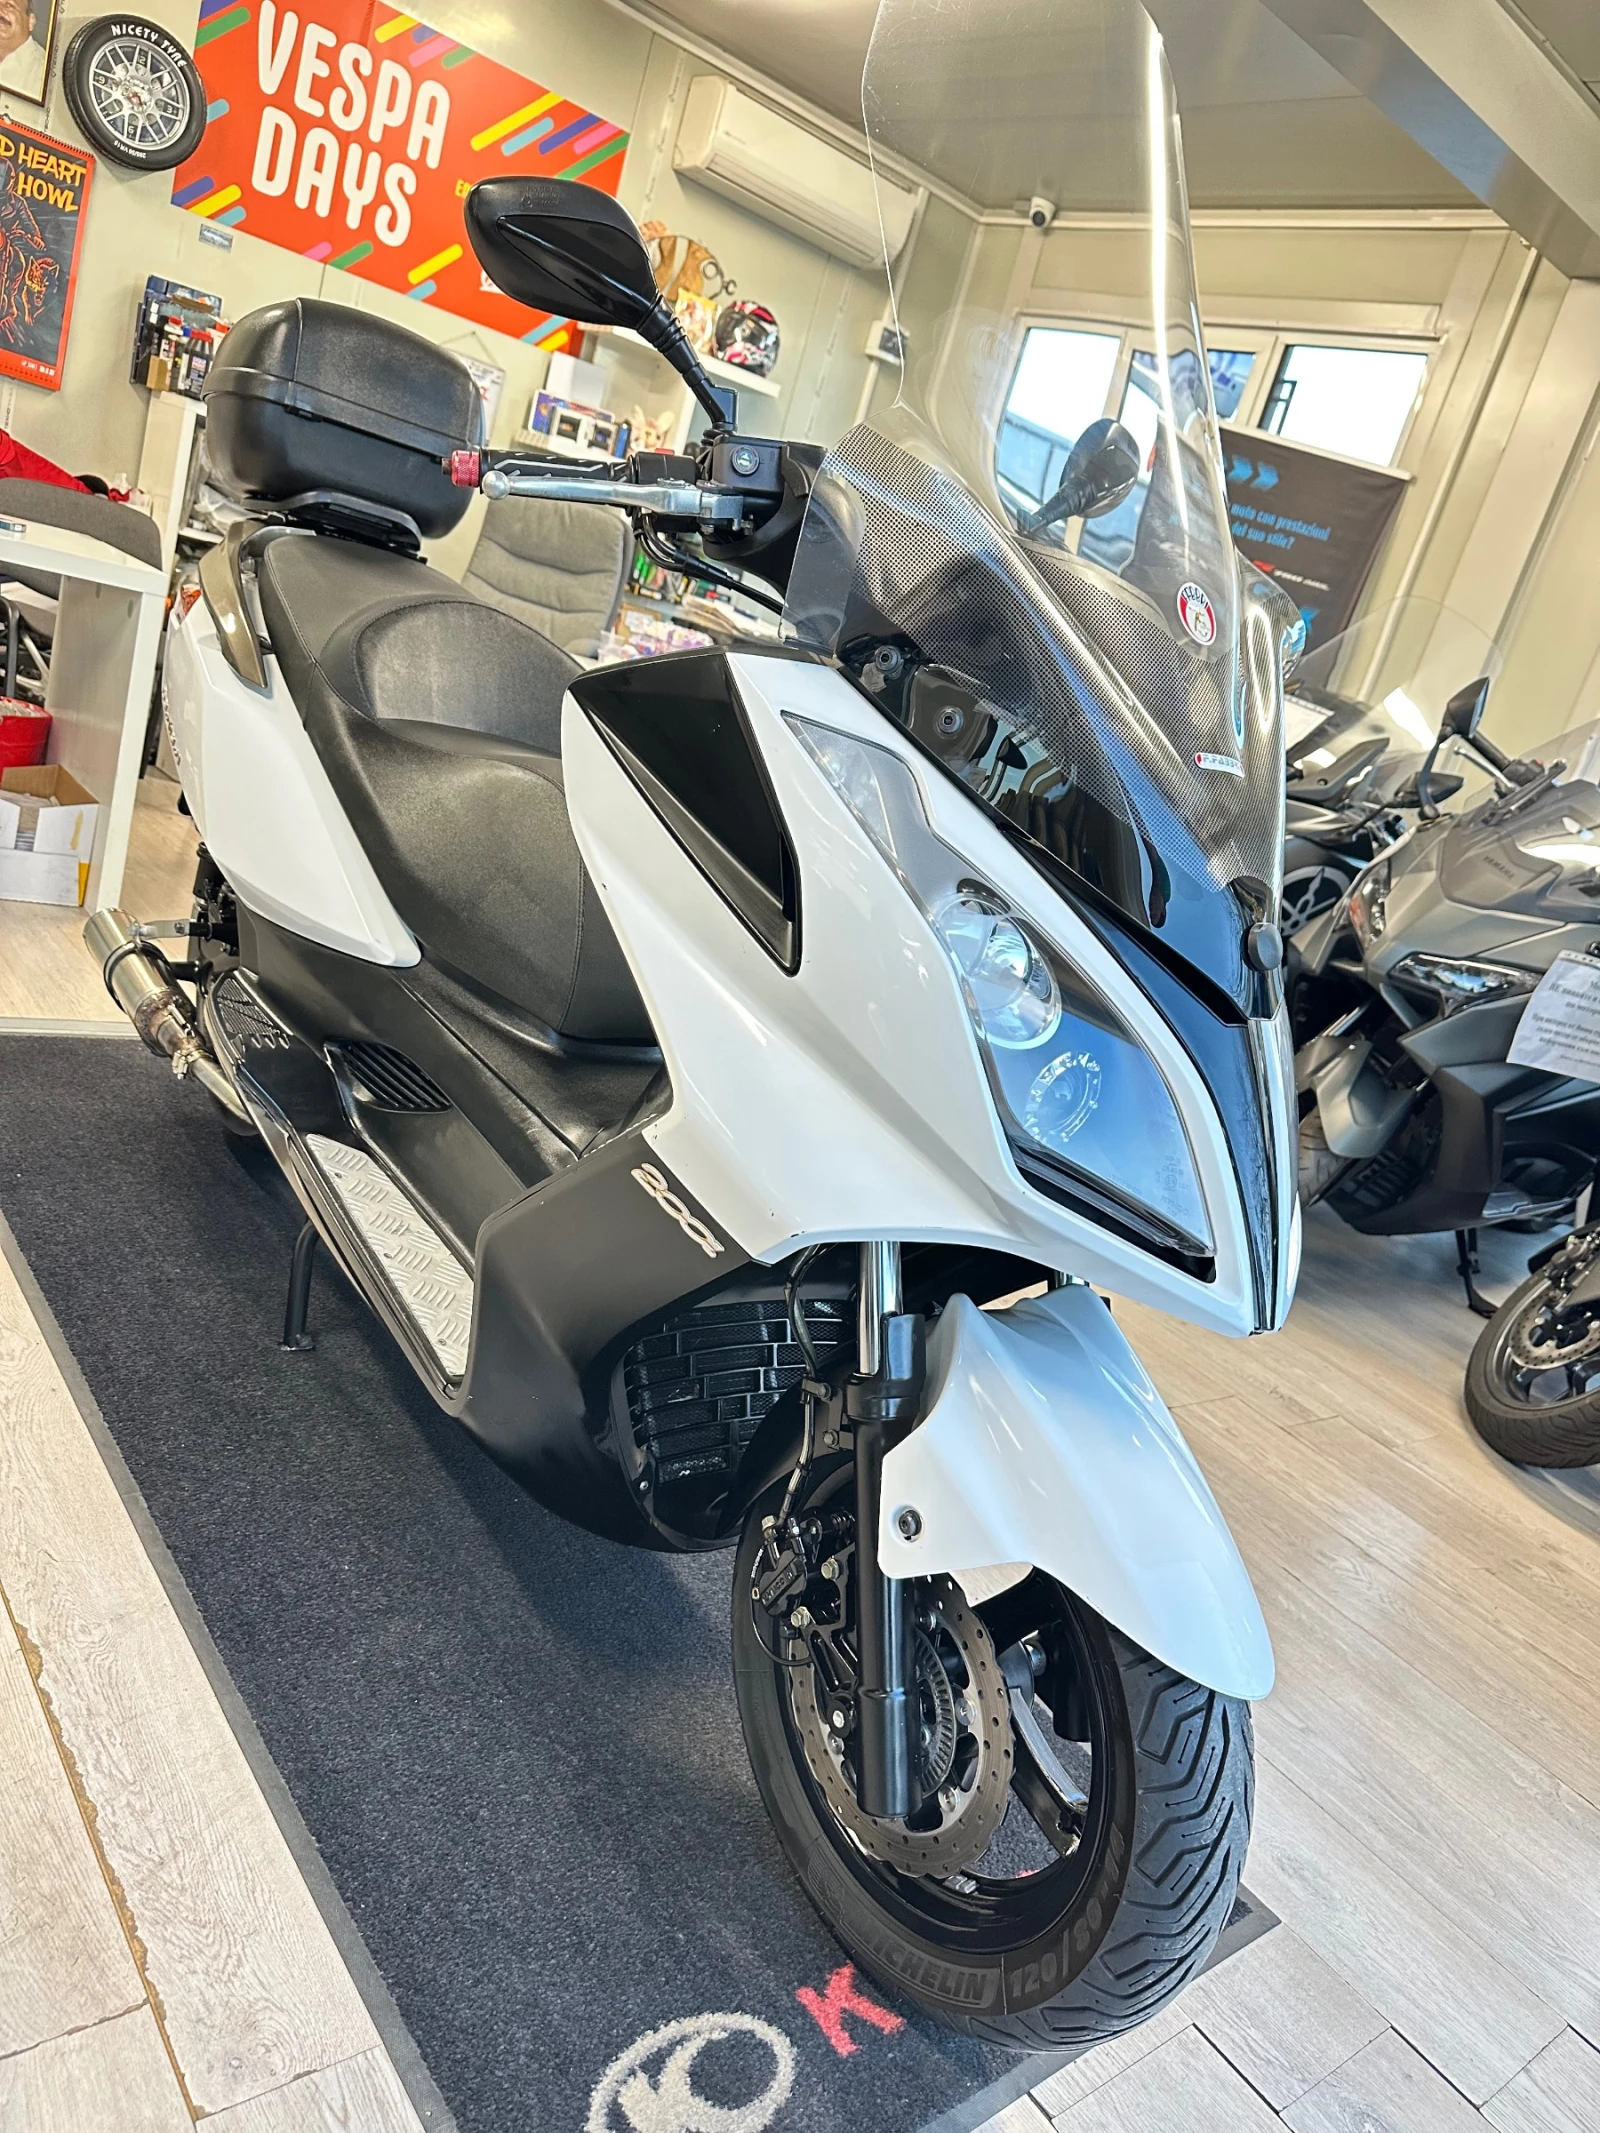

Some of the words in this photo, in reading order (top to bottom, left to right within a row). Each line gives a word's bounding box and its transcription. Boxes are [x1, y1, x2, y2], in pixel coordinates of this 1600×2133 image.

[111, 24, 158, 43] NICETY
[160, 40, 188, 68] TYRE
[258, 0, 450, 169] VESPA
[18, 142, 87, 187] HEART
[252, 105, 417, 247] DAYS
[17, 171, 79, 212] HOWL
[1230, 503, 1257, 520] moto
[1256, 511, 1276, 526] con
[1275, 516, 1331, 541] prestazioni
[1246, 527, 1266, 542] suo
[1266, 532, 1296, 550] stile?
[860, 1922, 988, 2001] MICHELIN
